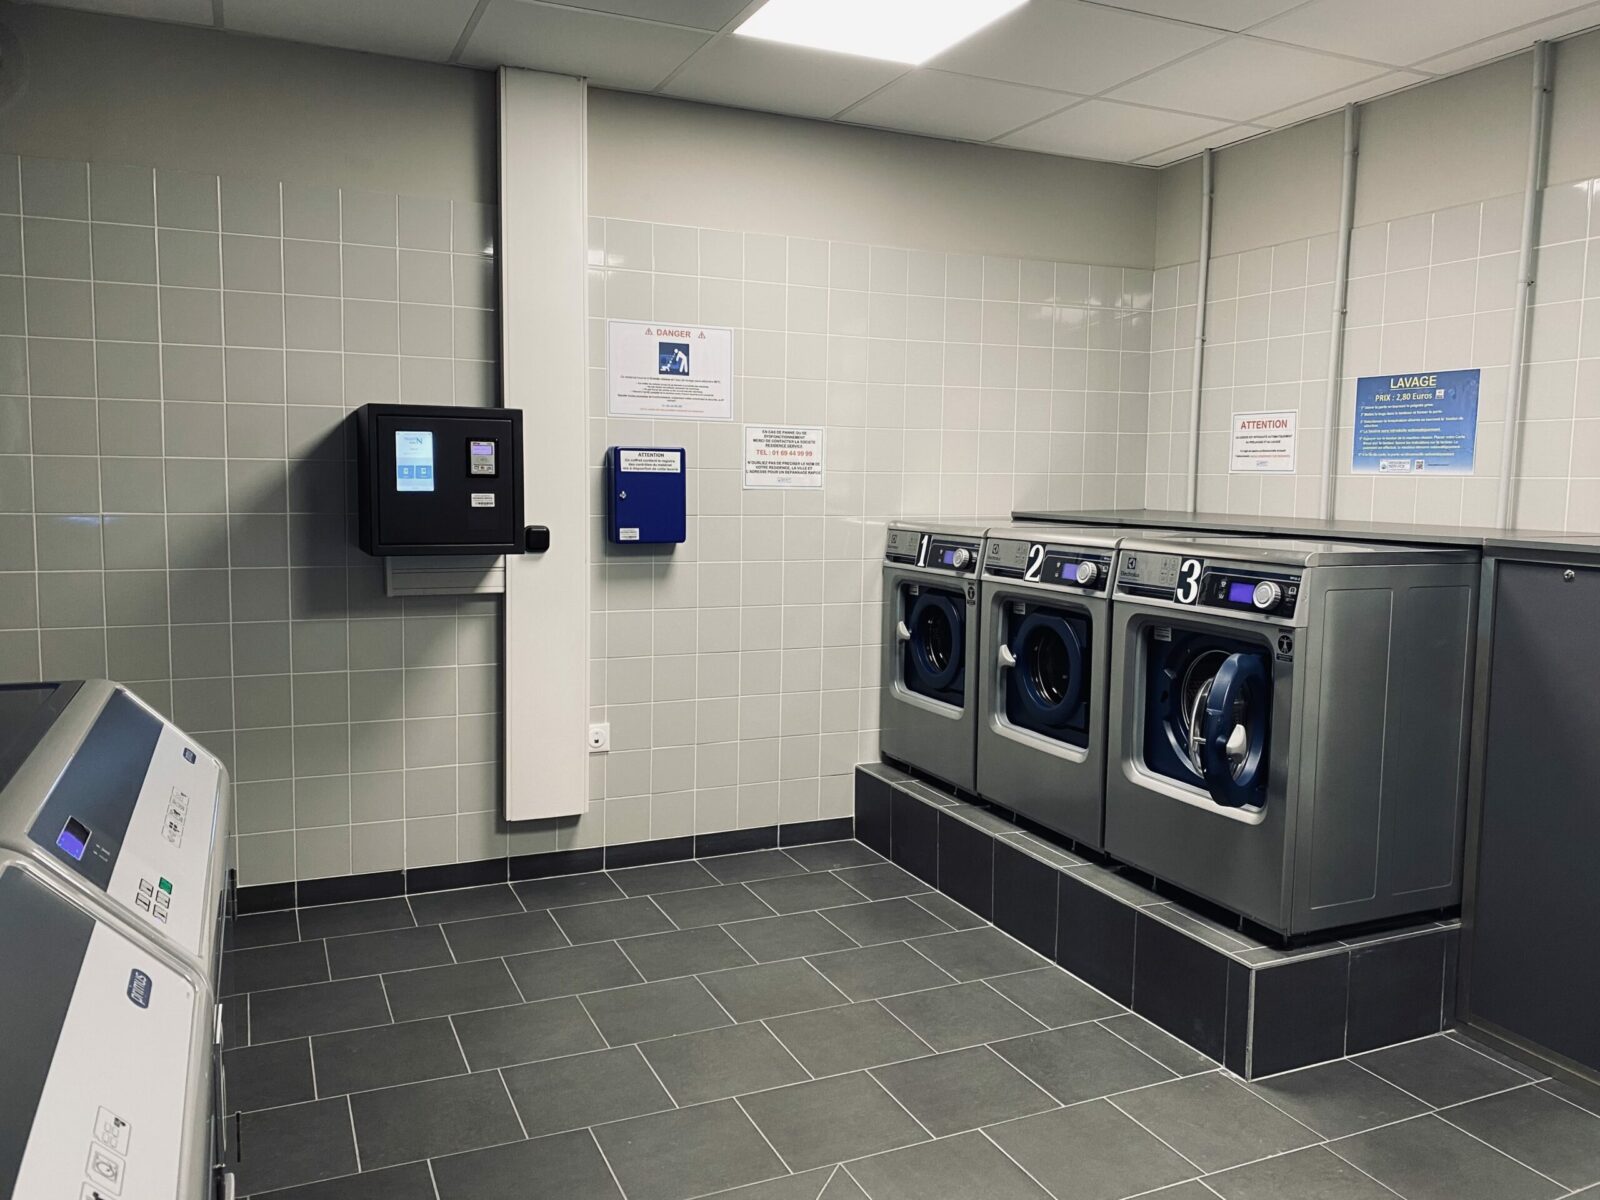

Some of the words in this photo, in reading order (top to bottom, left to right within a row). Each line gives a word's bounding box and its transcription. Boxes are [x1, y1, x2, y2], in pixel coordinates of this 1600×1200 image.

[656, 328, 691, 338] DANGER
[1390, 375, 1437, 389] LAVAGE
[1375, 394, 1390, 402] PRIX
[1396, 393, 1411, 402] 2,80
[1412, 392, 1433, 400] Euros
[1240, 419, 1288, 430] ATTENTION
[917, 534, 929, 567] 1
[1025, 544, 1045, 582] 2
[1177, 559, 1201, 604] 3
